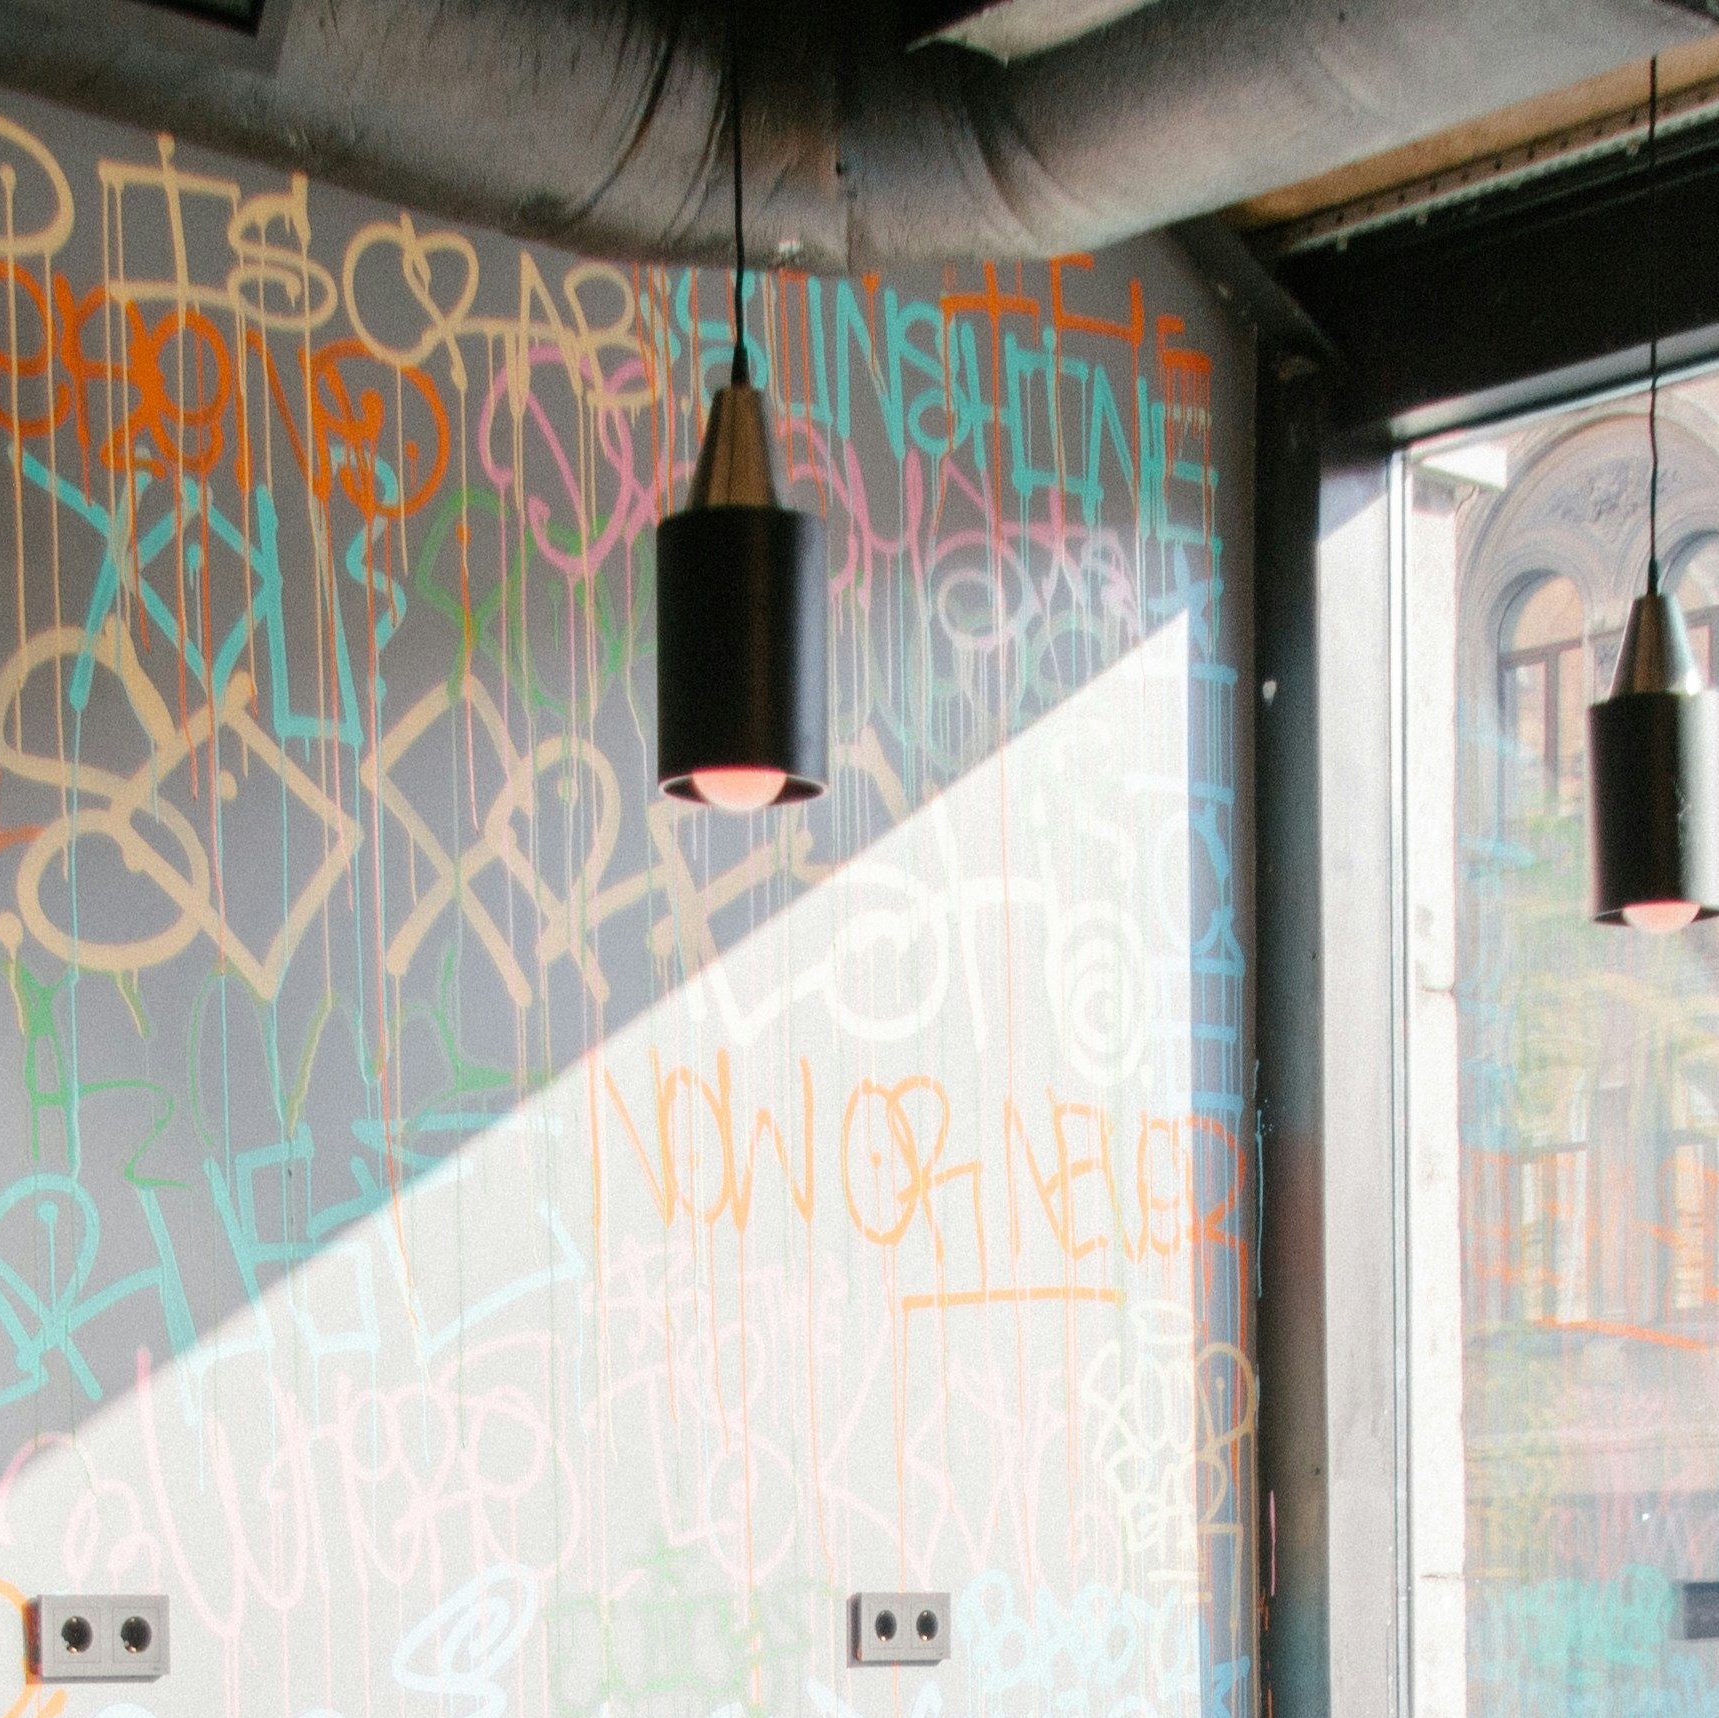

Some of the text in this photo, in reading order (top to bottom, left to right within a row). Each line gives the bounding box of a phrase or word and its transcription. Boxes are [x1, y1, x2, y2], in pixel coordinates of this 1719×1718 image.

[97, 132, 340, 332] IS
[587, 1045, 1250, 1280] NOW OR NEVER
